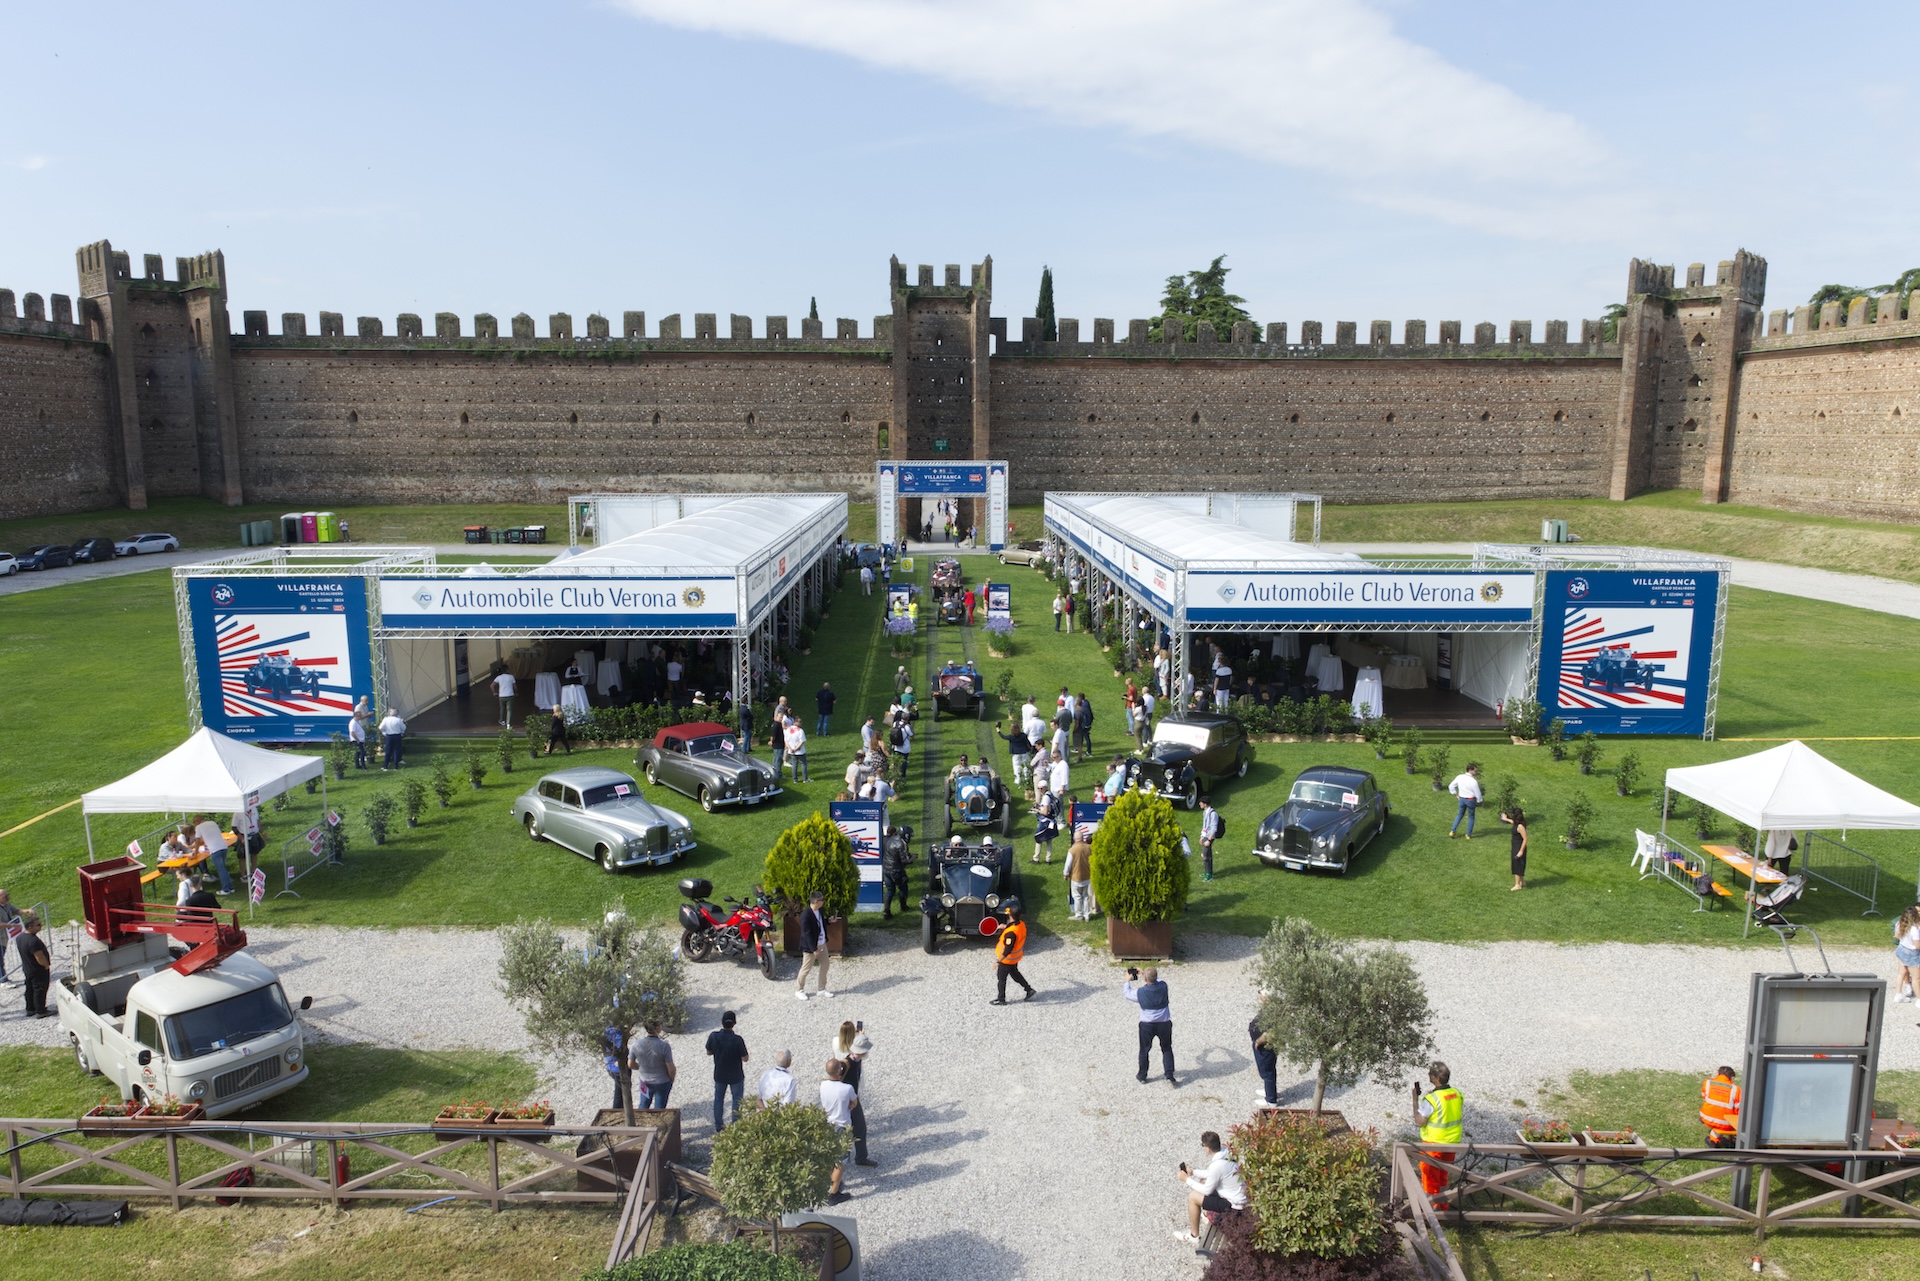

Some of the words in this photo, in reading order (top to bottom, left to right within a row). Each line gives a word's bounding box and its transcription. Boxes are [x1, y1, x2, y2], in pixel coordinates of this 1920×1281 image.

[277, 584, 343, 592] VILLAFRANCA
[1570, 581, 1585, 594] 2024
[1632, 578, 1696, 586] VILLAFRANCA
[215, 588, 231, 600] 2024
[440, 587, 553, 608] Automobile
[561, 587, 604, 608] Club
[608, 588, 677, 608] Verona
[1243, 582, 1354, 602] Automobile
[1361, 581, 1404, 602] Club
[1408, 582, 1474, 602] Verona
